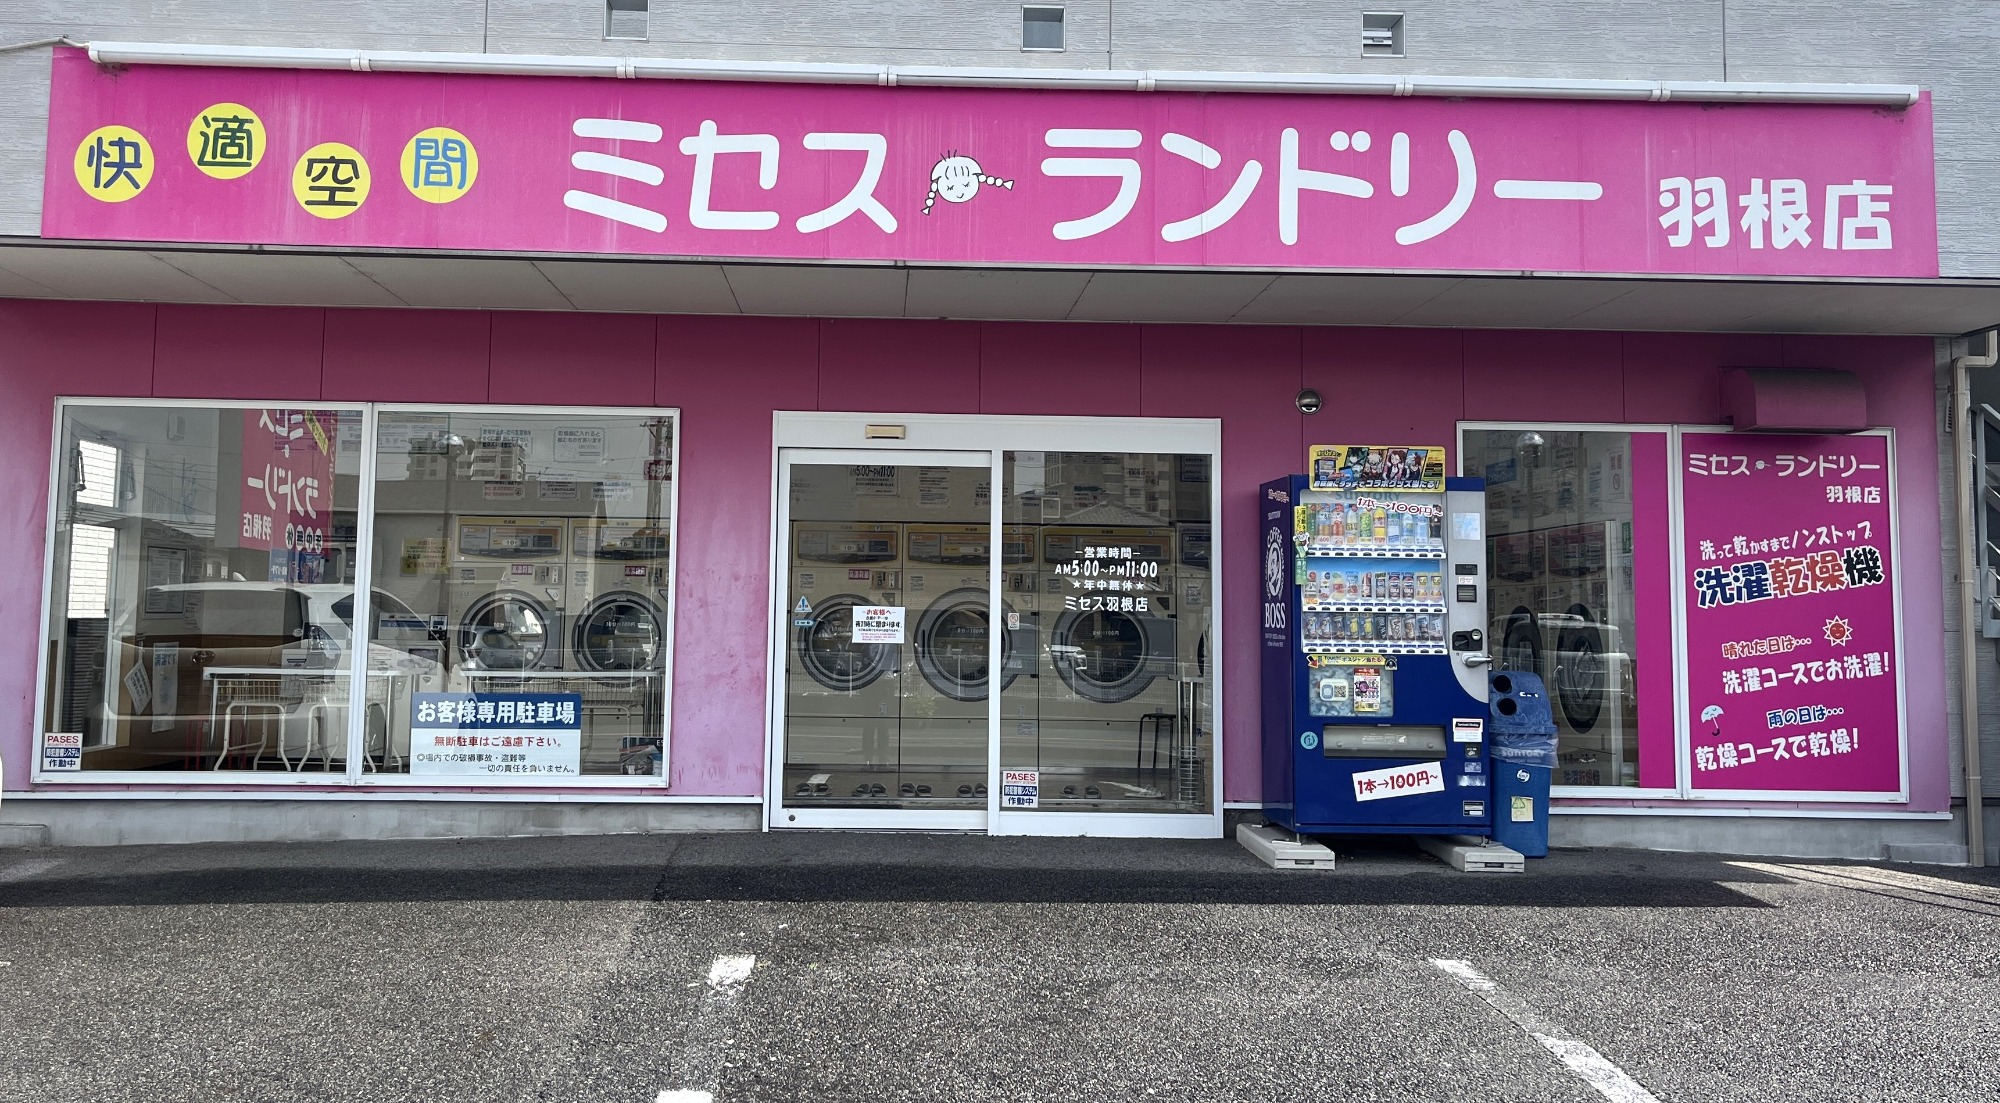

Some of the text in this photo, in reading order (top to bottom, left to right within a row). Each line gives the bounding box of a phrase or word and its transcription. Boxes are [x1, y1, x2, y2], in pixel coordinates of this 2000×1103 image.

[86, 114, 468, 207] 快適空間
[563, 117, 1894, 251] ミセス ランドリー 羽根店
[1688, 453, 1881, 478] ミセス ランドリー
[1826, 485, 1881, 504] 羽根店
[1694, 546, 1886, 608] 洗濯乾燥機
[1064, 595, 1149, 612] ミセス羽根店
[1264, 602, 1286, 629] BOSS
[1722, 651, 1890, 695] 洗濯コースでお洗濯!
[417, 700, 576, 725] お客様専用駐車場
[47, 735, 79, 744] PASES
[434, 735, 564, 747] 無断駐車はご遠慮下さい。
[1695, 727, 1859, 771] 乾燥コースで乾燥!
[1006, 773, 1036, 782] PASES
[1008, 797, 1034, 806] 作動中
